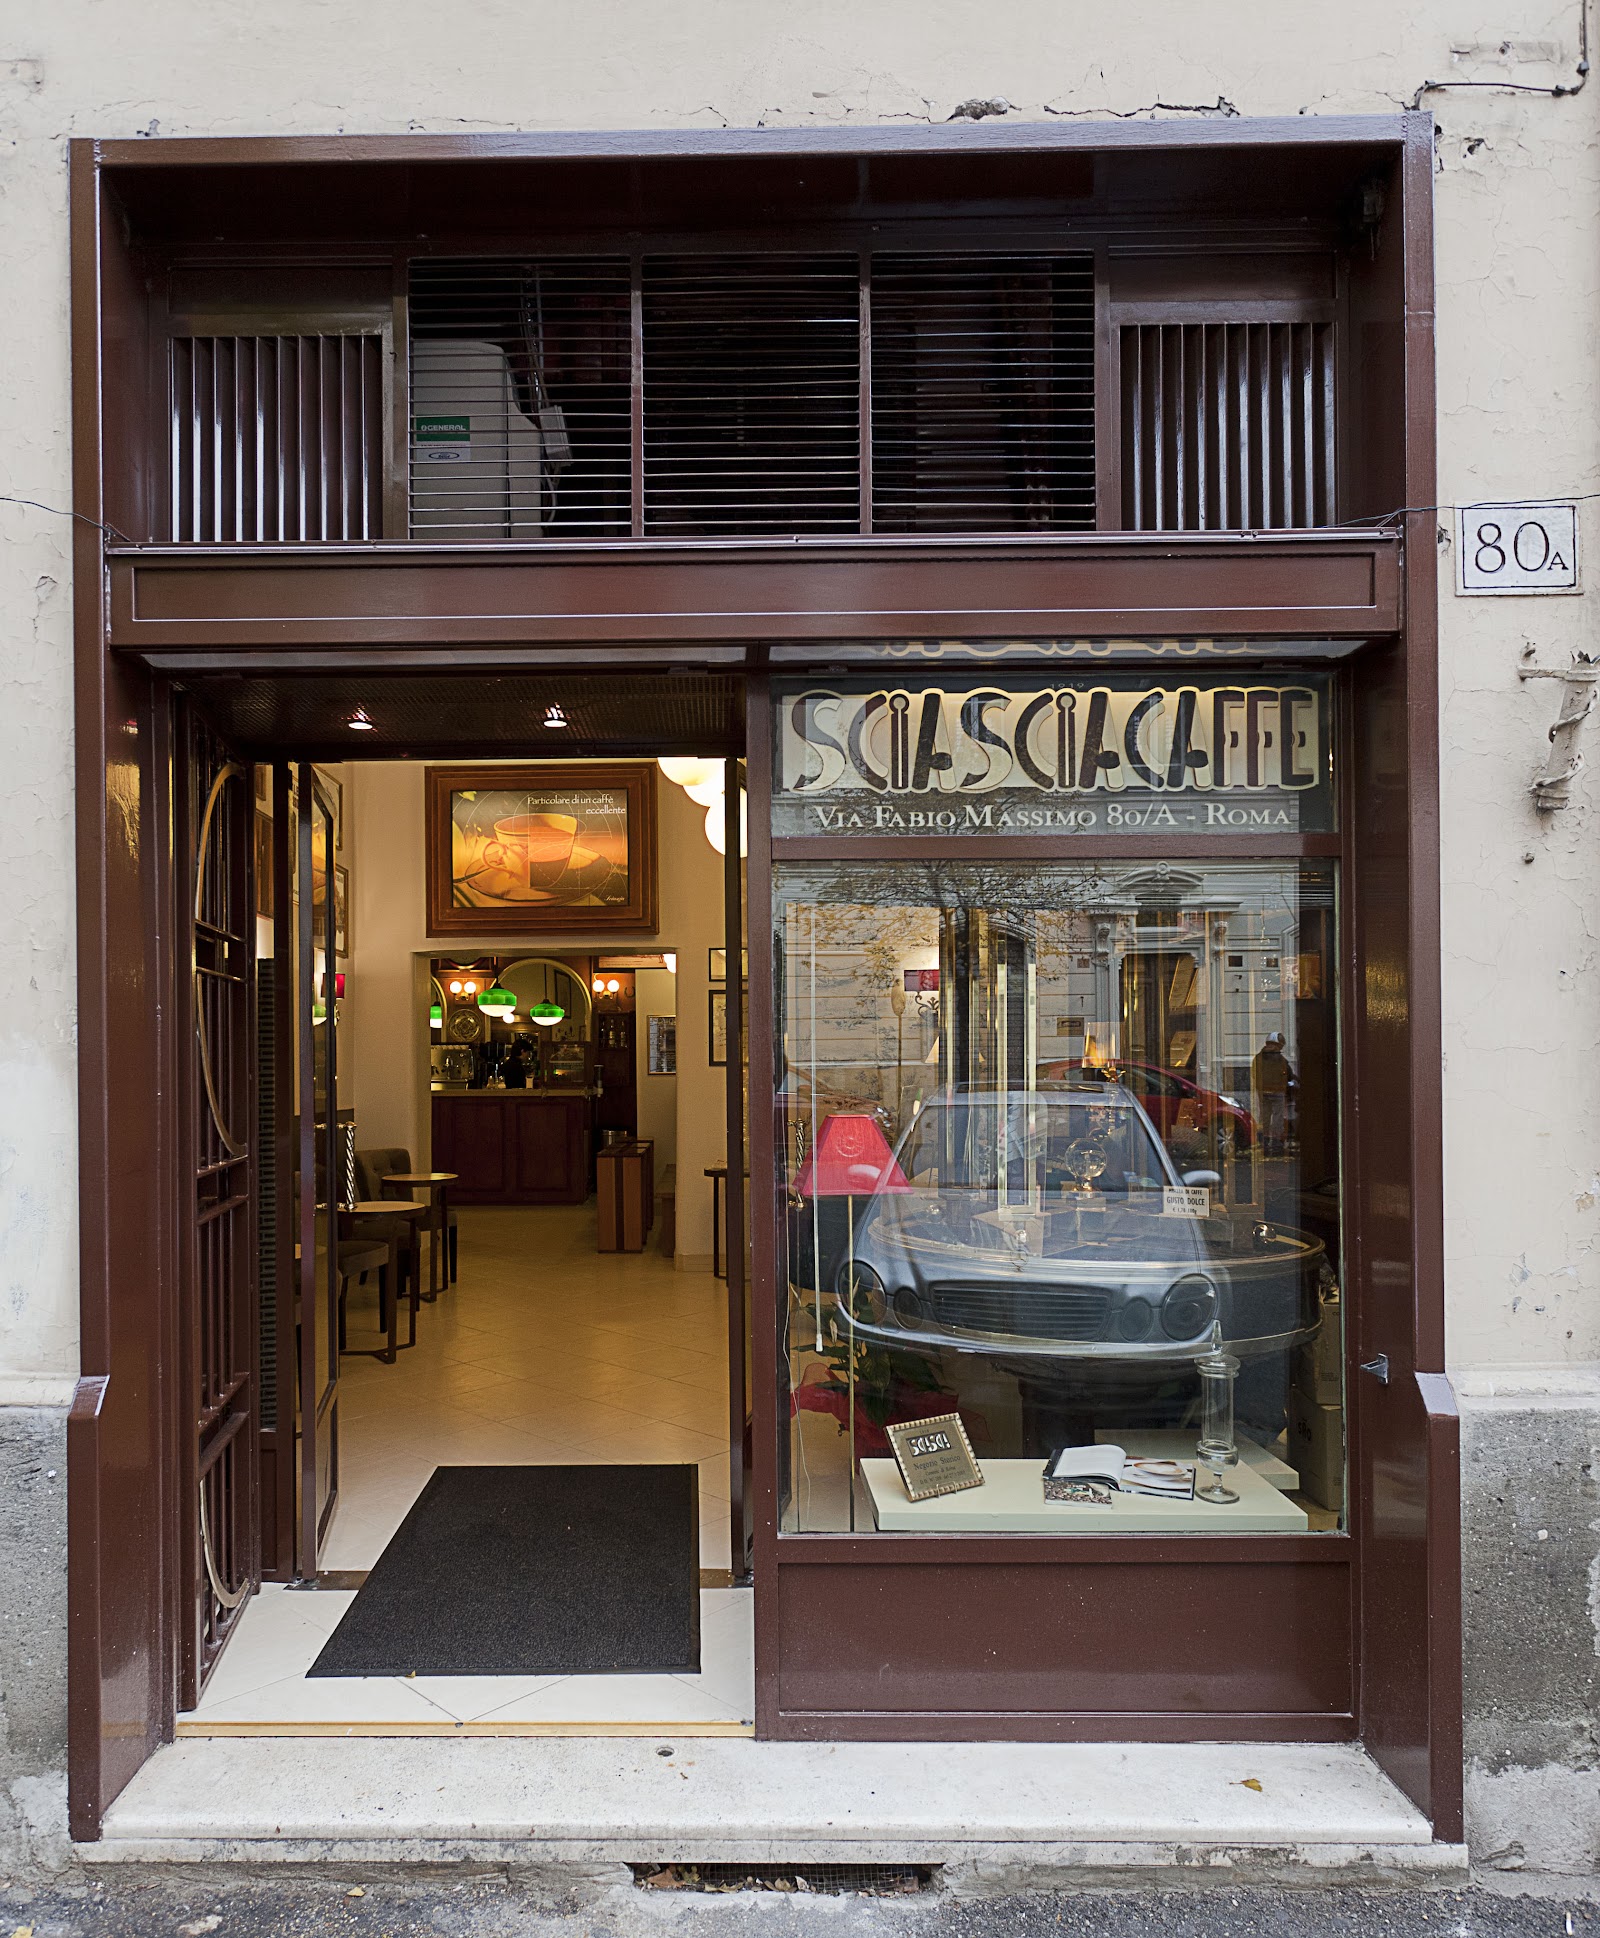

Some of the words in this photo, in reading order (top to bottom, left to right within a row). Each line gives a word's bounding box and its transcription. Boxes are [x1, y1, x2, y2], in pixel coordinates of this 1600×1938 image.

[527, 794, 570, 805] Particolare
[571, 794, 580, 804] di
[585, 804, 626, 814] eccellente
[813, 804, 864, 828] VIA
[874, 804, 957, 828] FABIO
[963, 803, 1097, 828] MASSIMO
[1204, 802, 1292, 826] ROMA
[1166, 1196, 1185, 1205] GUSTO
[1187, 1197, 1205, 1206] DOLCE
